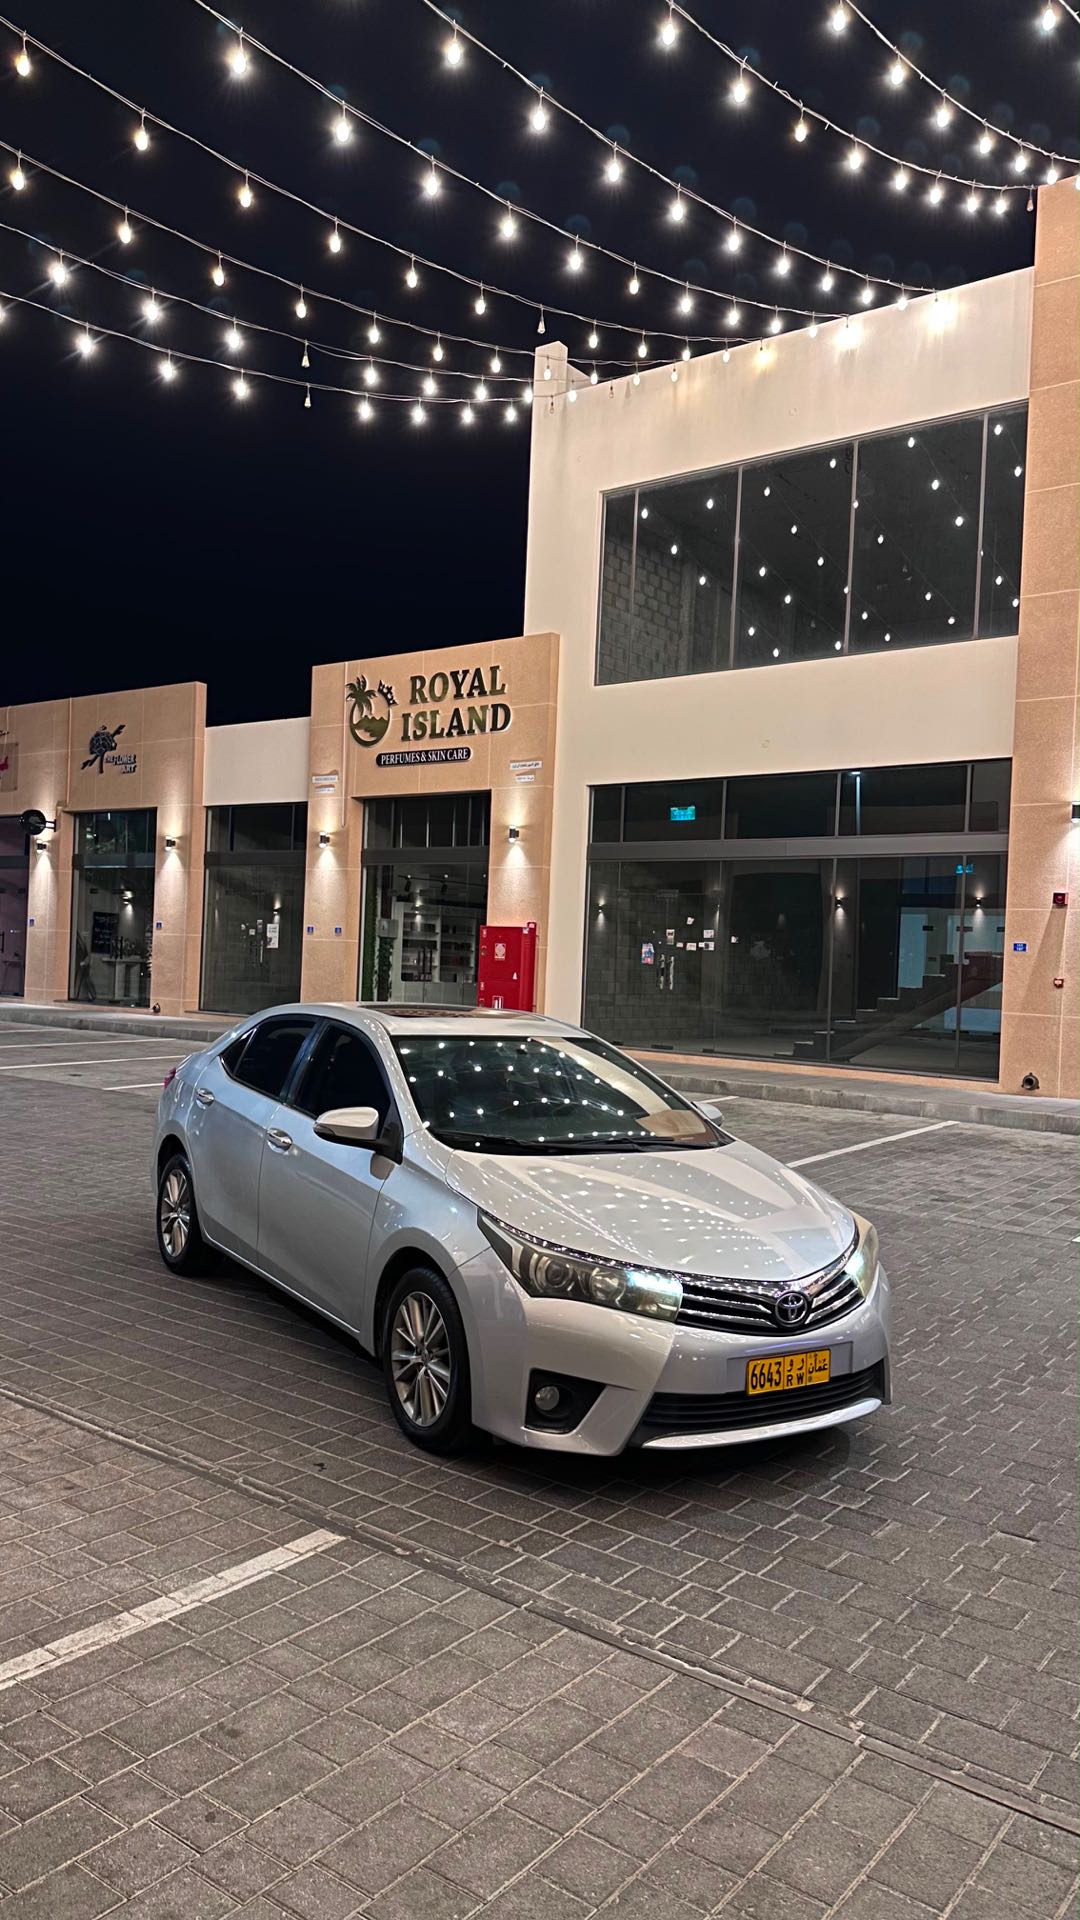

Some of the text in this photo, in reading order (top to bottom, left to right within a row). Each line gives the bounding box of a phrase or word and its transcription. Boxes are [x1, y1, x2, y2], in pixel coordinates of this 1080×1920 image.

[409, 665, 508, 705] ROYAL
[401, 703, 512, 741] ISLAND
[122, 765, 137, 774] ART
[381, 748, 469, 765] PERFUMES & SKIN CARE
[751, 1361, 782, 1390] 6643
